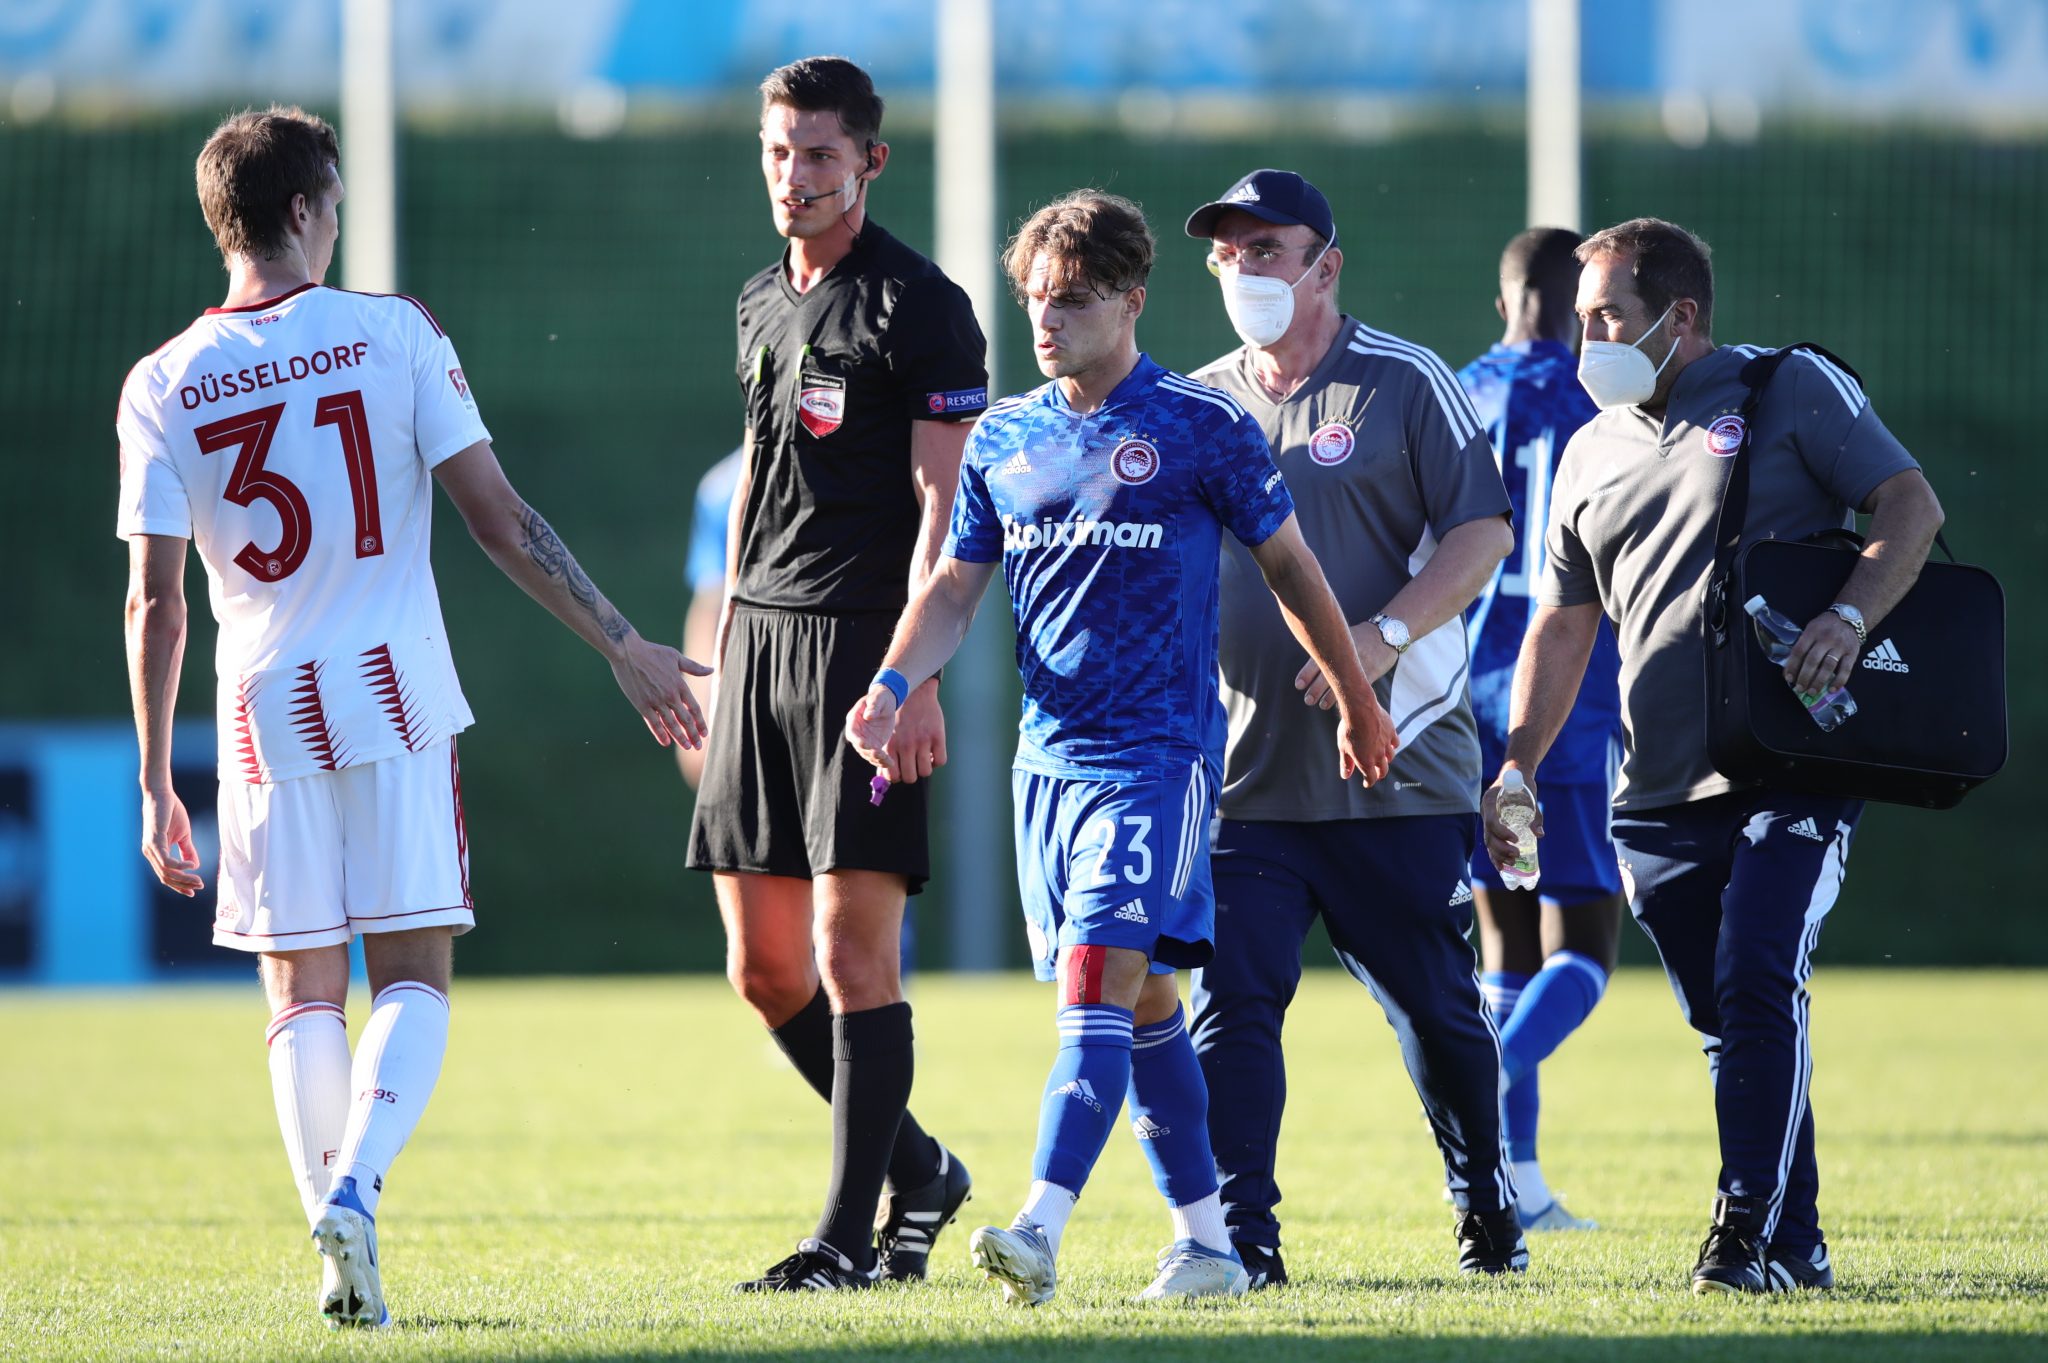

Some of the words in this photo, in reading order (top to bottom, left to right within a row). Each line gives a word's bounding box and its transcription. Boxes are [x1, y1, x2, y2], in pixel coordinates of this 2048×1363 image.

[250, 314, 279, 327] 1895
[180, 342, 369, 410] DÜSSELDORF
[946, 393, 987, 407] RESPECT
[1001, 465, 1032, 475] adidas
[194, 389, 384, 583] 31
[1862, 658, 1909, 673] adidas
[1787, 824, 1824, 842] adidas
[1090, 815, 1152, 886] 23
[1449, 892, 1472, 907] adida
[1114, 909, 1149, 924] adidas
[1050, 1085, 1102, 1112] didas
